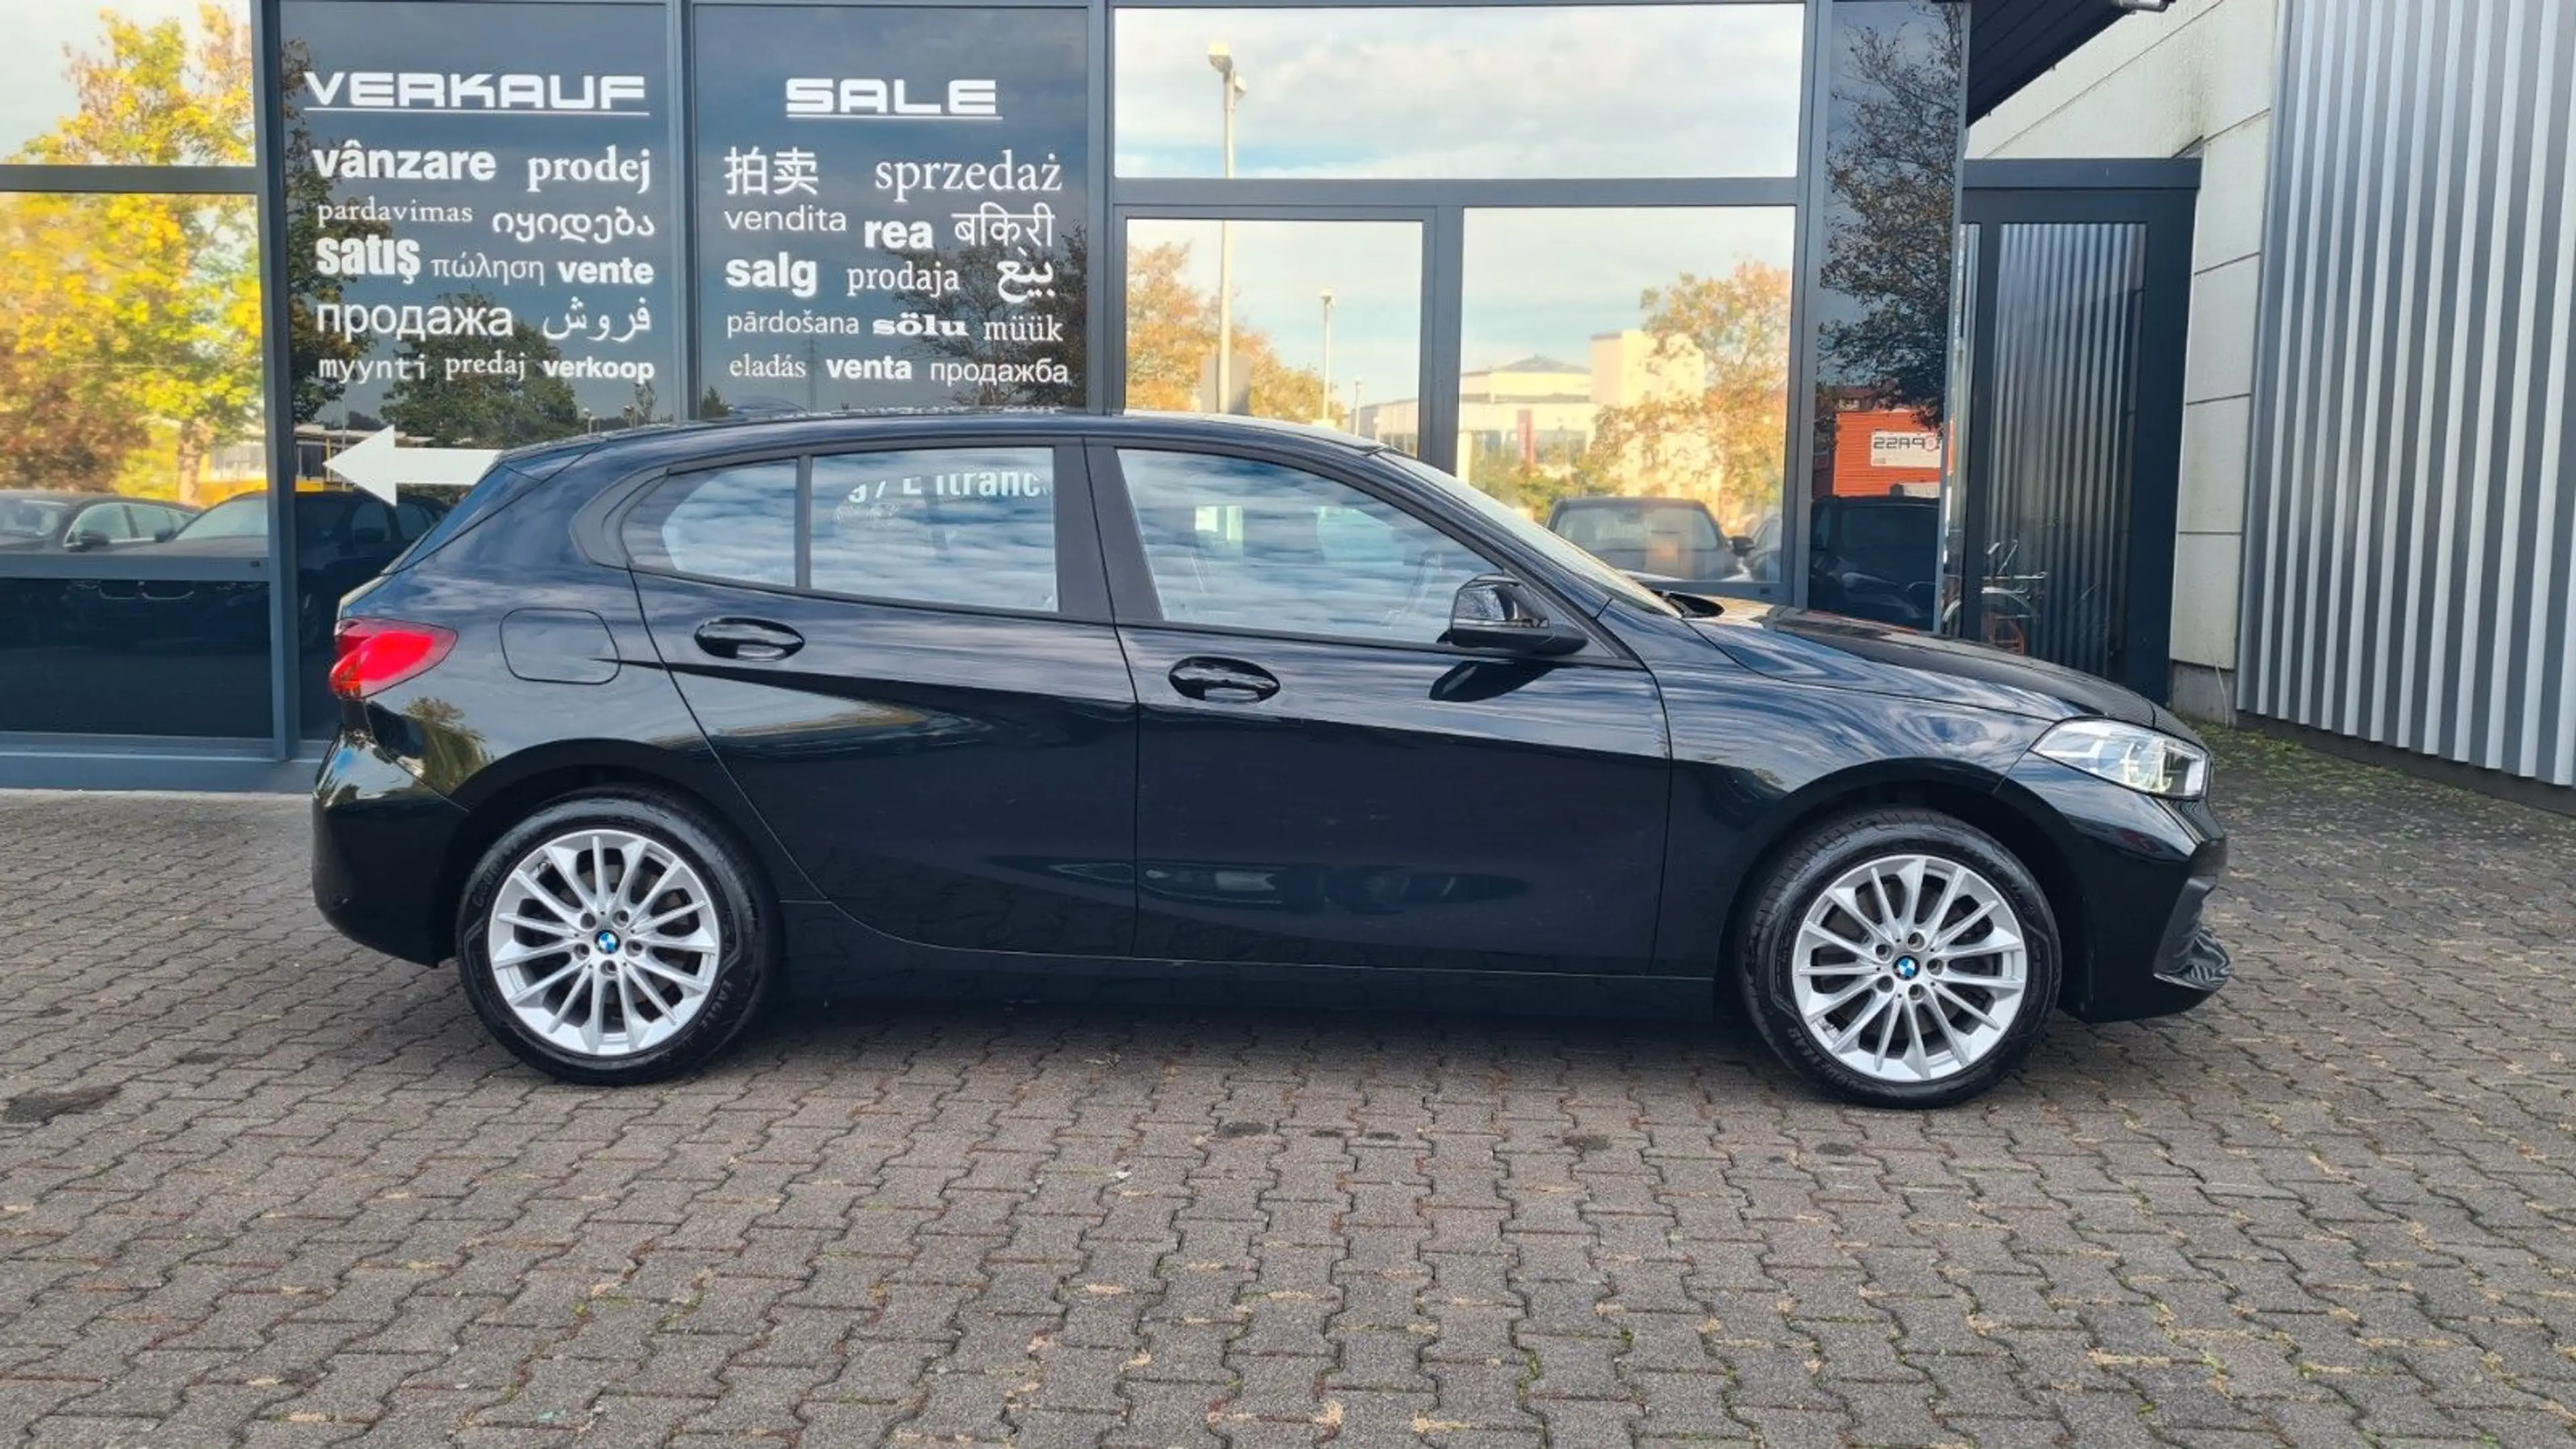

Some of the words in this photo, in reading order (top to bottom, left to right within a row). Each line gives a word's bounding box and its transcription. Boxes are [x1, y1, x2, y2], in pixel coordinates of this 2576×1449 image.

[304, 72, 646, 109] VERKAUF
[786, 78, 997, 114] SALE
[311, 139, 497, 181] vânzare
[527, 144, 650, 195] prodej
[724, 146, 819, 196] 拍卖
[875, 149, 1063, 203] sprzedaż
[317, 195, 473, 228] pardavimas
[492, 205, 655, 244] იყიდება
[724, 204, 847, 231] vendita
[864, 221, 934, 250] rea
[430, 251, 545, 286] πώληση
[557, 257, 654, 284] vente
[725, 252, 817, 298] salg
[846, 260, 961, 299] prodaja
[317, 303, 513, 343] продажа
[727, 309, 859, 339] pārdošana
[872, 312, 969, 337] sölu
[983, 314, 1063, 342] müük
[319, 354, 425, 385] myynti
[445, 349, 525, 382] predaj
[543, 356, 655, 385] verkoop
[729, 353, 806, 378] eladás
[826, 355, 912, 380] venta
[930, 358, 1069, 388] продажба
